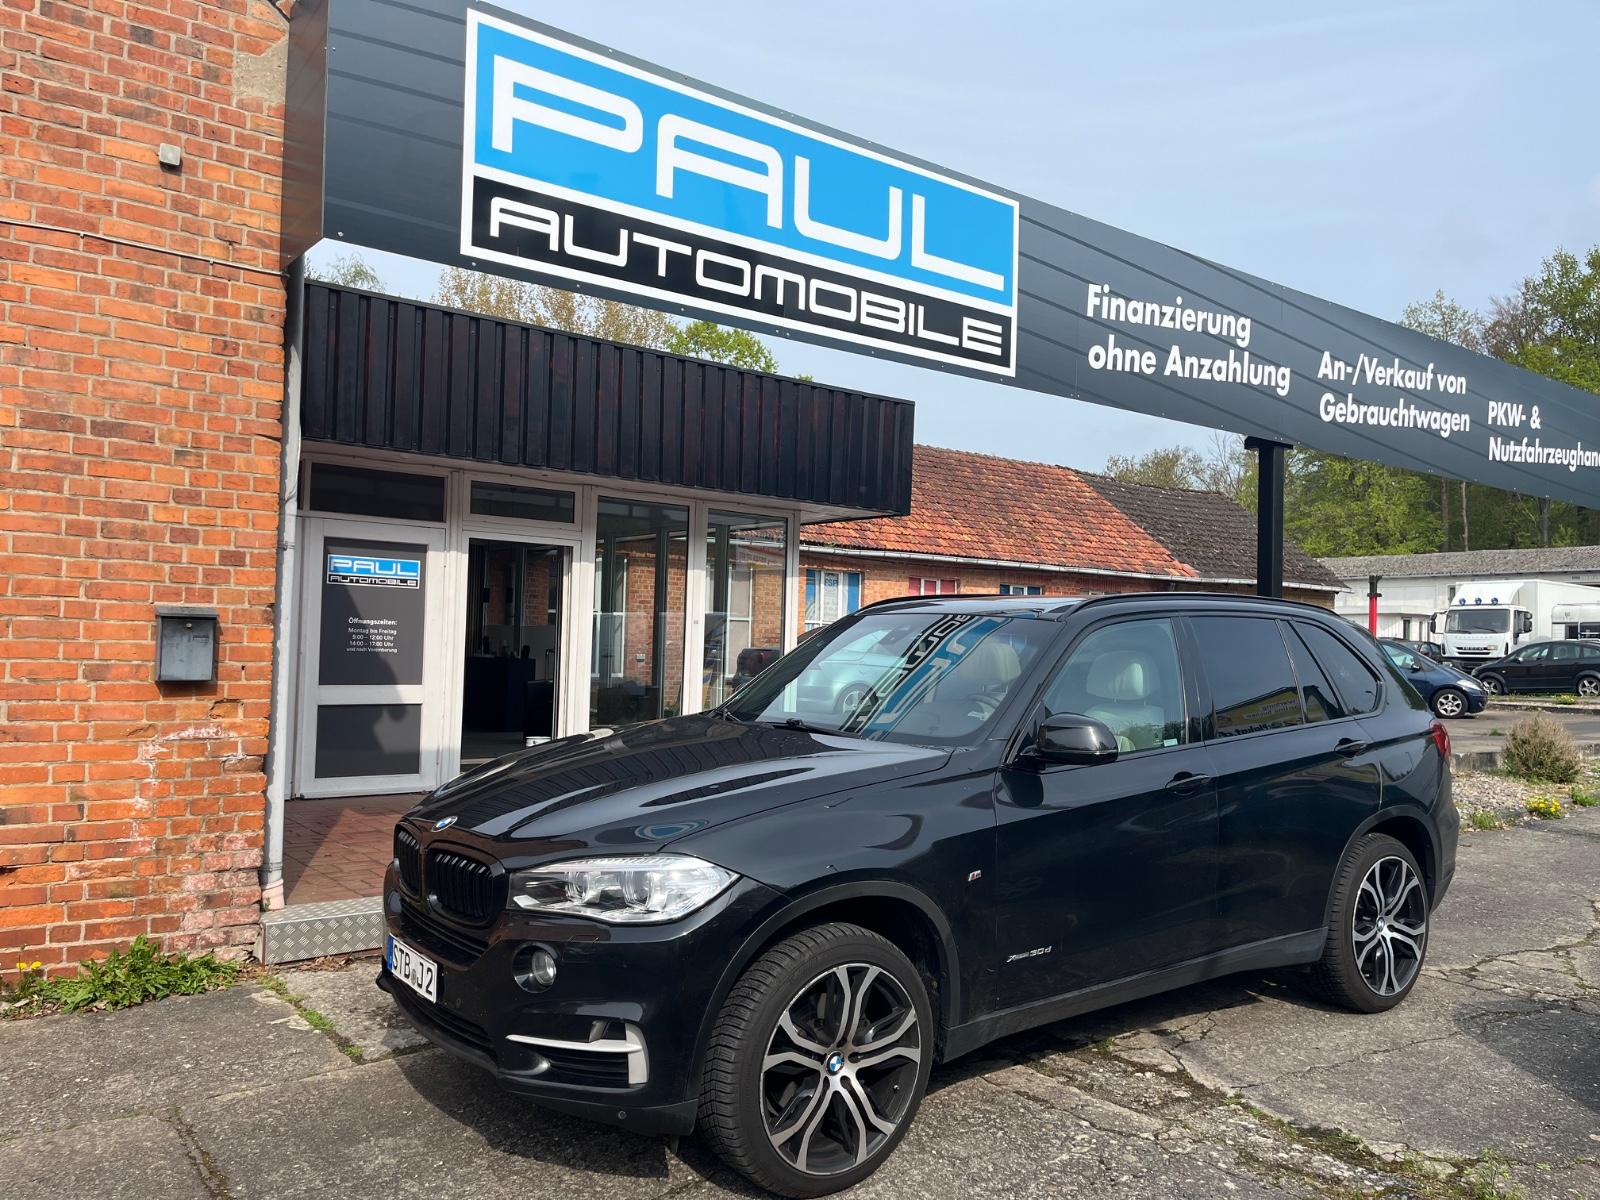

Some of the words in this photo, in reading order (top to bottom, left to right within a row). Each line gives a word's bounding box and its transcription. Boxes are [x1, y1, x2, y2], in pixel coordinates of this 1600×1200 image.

[490, 54, 1004, 291] PAUL
[489, 196, 1002, 356] AUTOMOBILE
[1086, 283, 1252, 348] Finanzierung
[1088, 334, 1156, 375] ohne
[1163, 345, 1291, 396] Anzahlung
[1317, 351, 1434, 391] An-/Verkauf
[1437, 373, 1466, 395] von
[1319, 392, 1470, 438] Gebrauchtwagen
[1487, 400, 1526, 427] PKW-
[1529, 405, 1541, 429] &
[1488, 436, 1600, 472] Nutzfahrzeughan
[330, 575, 417, 586] AUTOMOBILE
[331, 559, 417, 575] PAUL
[393, 944, 412, 980] STB
[416, 961, 433, 996] J2
